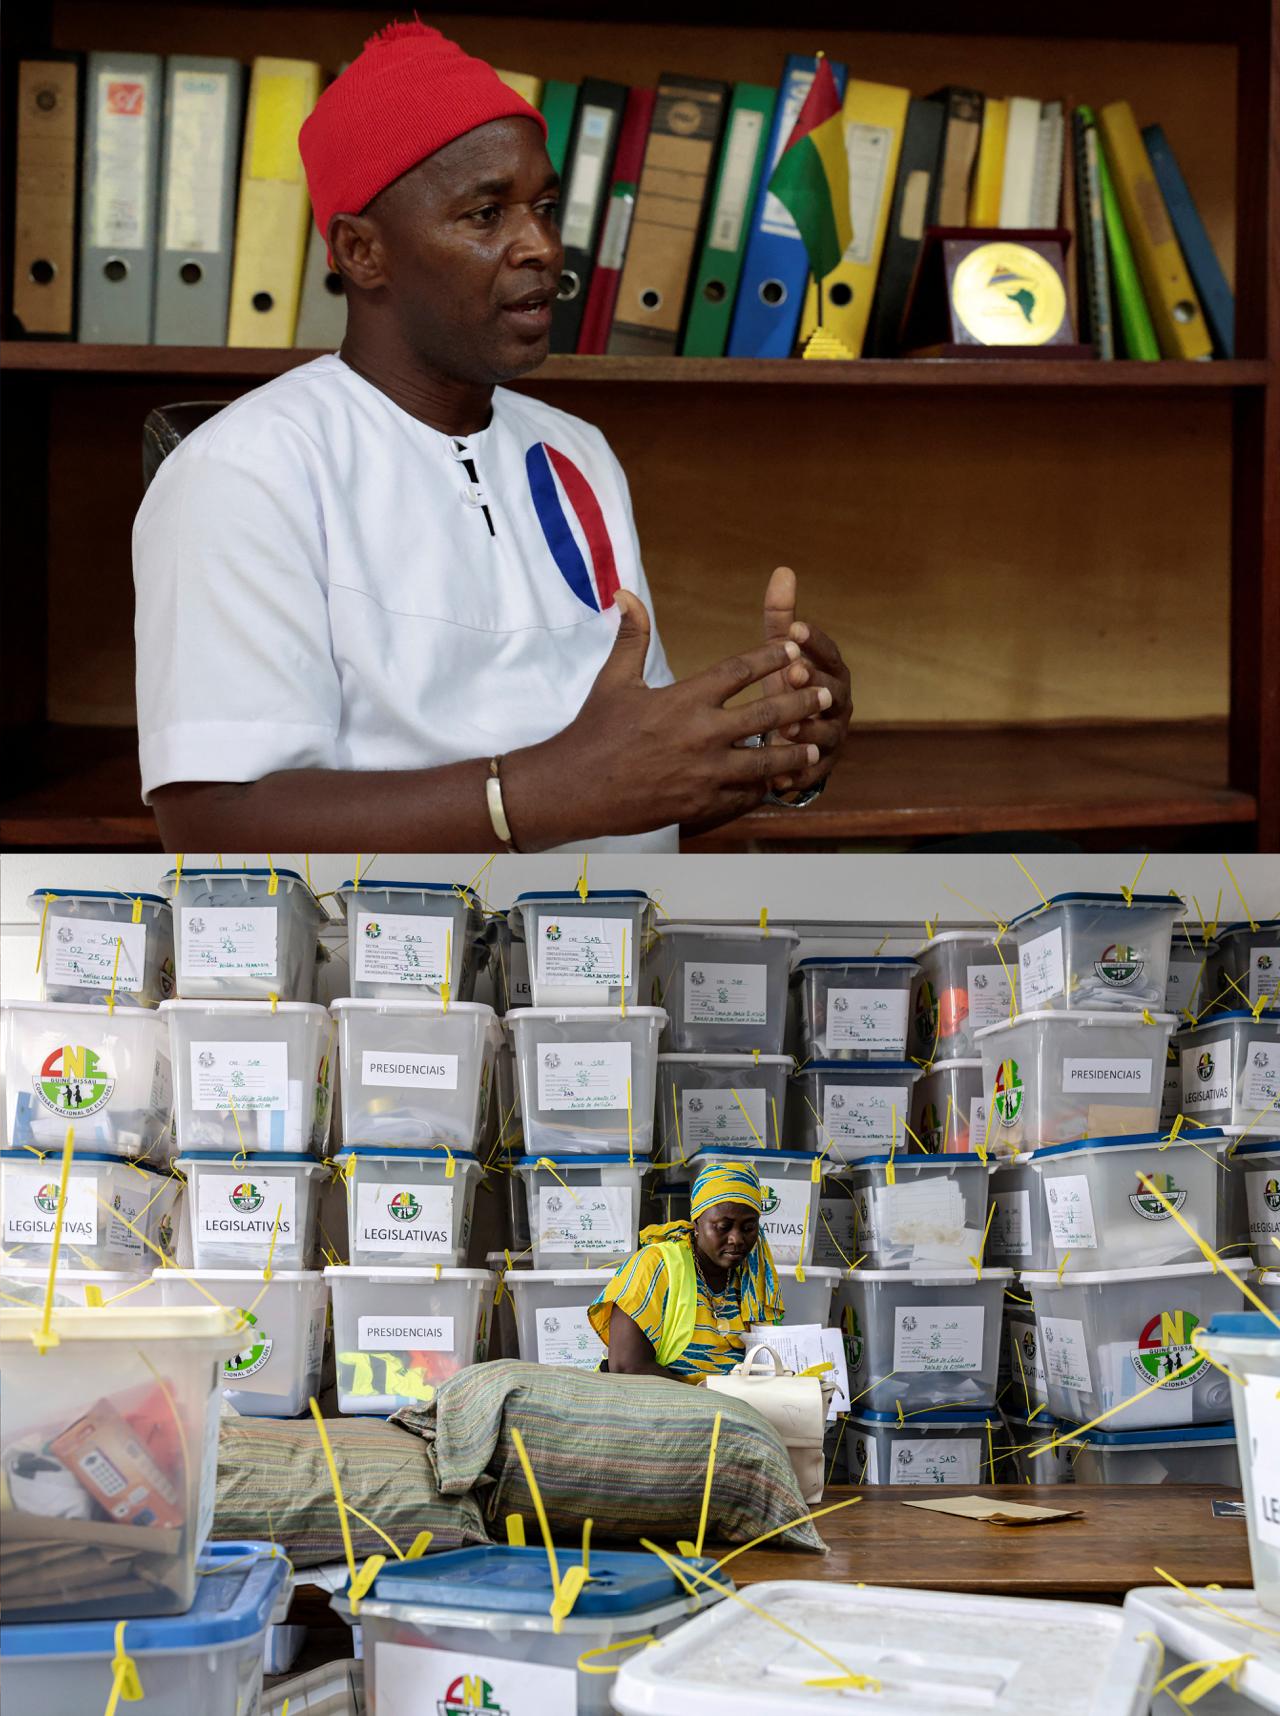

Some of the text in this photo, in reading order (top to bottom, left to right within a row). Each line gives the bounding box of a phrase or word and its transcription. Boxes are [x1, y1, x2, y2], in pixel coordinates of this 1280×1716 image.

[584, 936, 601, 944] SAB
[70, 946, 83, 954] 02
[41, 1044, 107, 1079] CNE
[370, 1063, 446, 1076] PRESIDENCIAIS
[1071, 1070, 1141, 1080] PRESIDENCIAIS
[1185, 1087, 1228, 1104] LEGISLATIVAS
[55, 1107, 85, 1116] NACIONAL
[233, 1183, 260, 1197] CNE
[391, 1192, 419, 1206] CNE
[206, 1220, 290, 1232] LEGISLATIVAS
[763, 1222, 804, 1235] ATIVAS
[365, 1228, 448, 1242] LEGISLATIVAS
[367, 1327, 443, 1337] PRESIDENCIAIS
[1133, 1357, 1155, 1383] COMISSÃO
[446, 1673, 500, 1709] CNE
